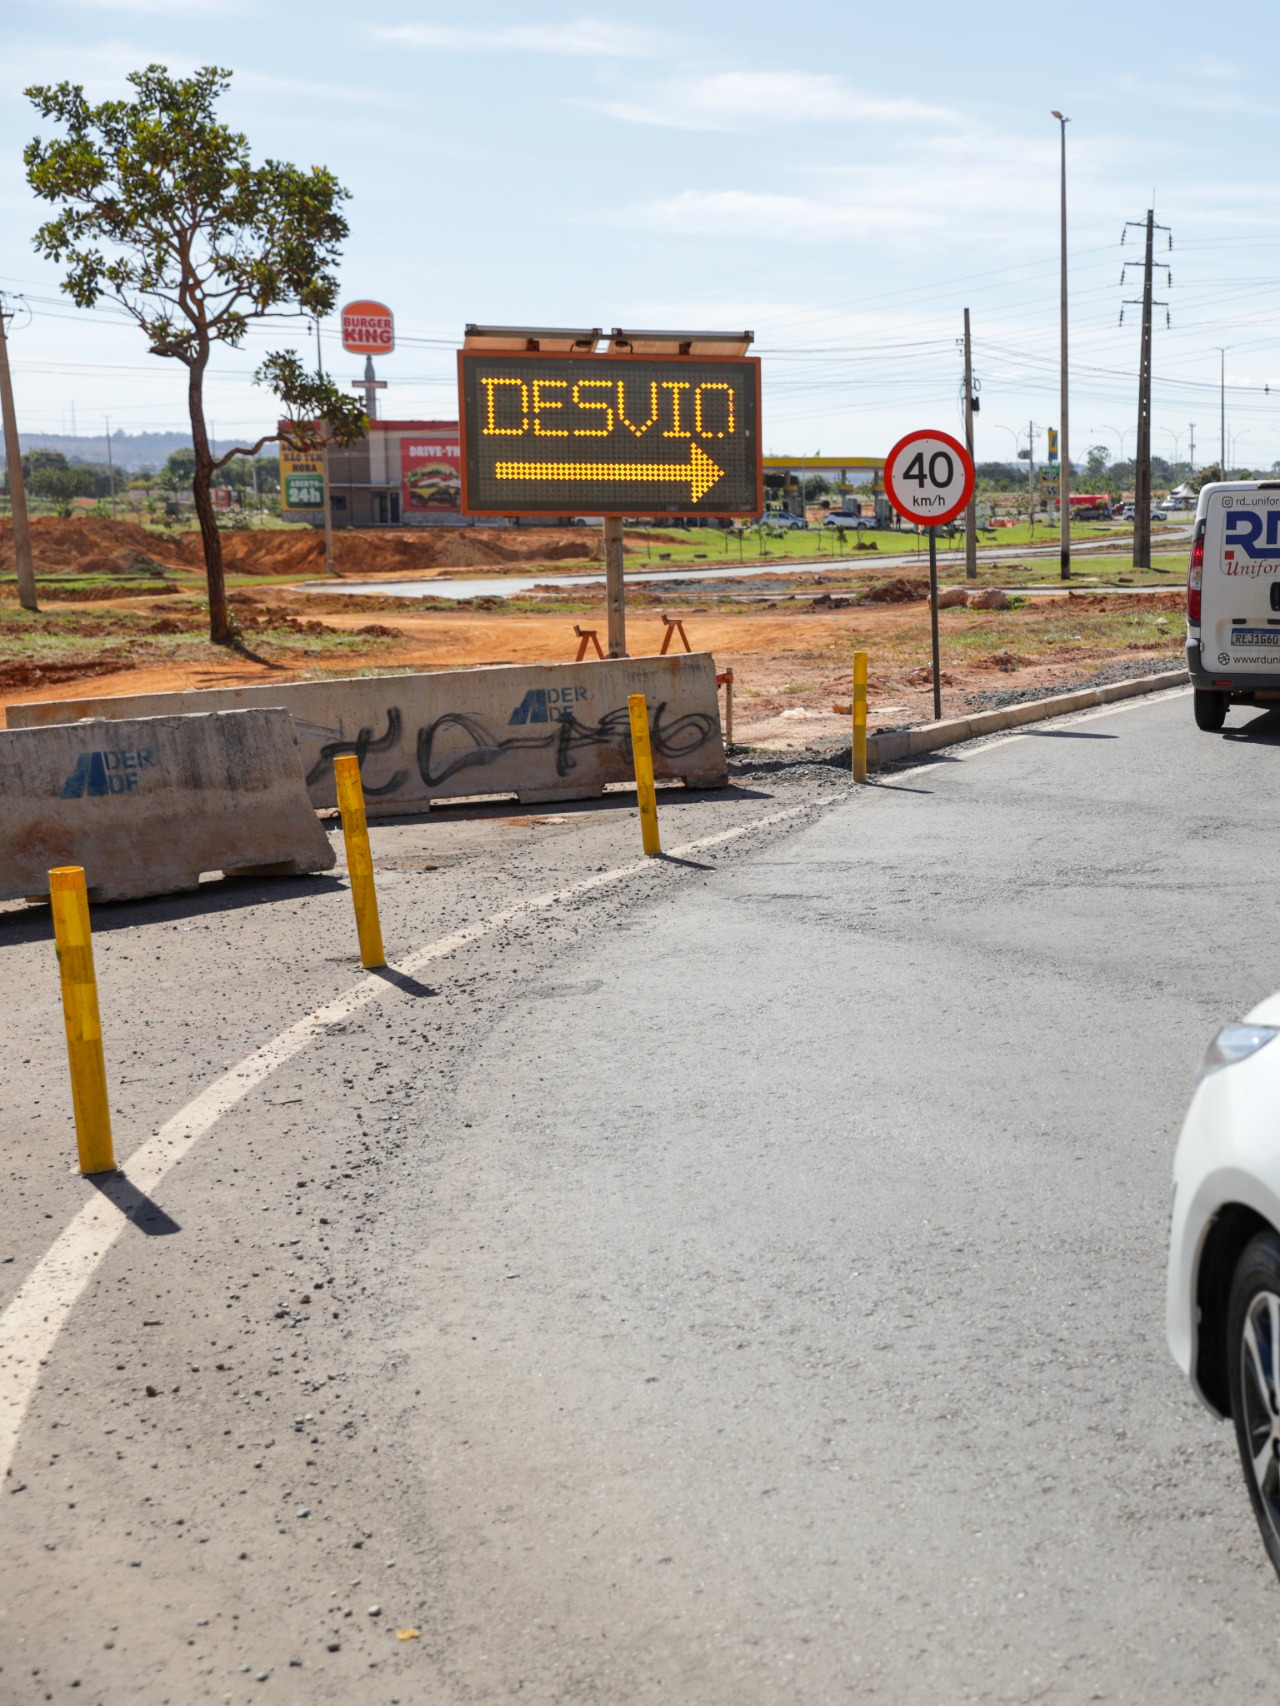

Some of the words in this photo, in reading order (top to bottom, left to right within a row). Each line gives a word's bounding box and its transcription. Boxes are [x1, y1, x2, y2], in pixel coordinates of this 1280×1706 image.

[343, 317, 392, 328] BURGER
[344, 328, 392, 344] KING
[480, 377, 736, 438] DESVIO
[292, 464, 317, 472] HORA
[902, 451, 954, 488] 40
[289, 488, 321, 503] 24h
[913, 494, 946, 507] km/h
[547, 686, 589, 703] DER
[103, 747, 155, 770] DER
[109, 772, 138, 794] DF
